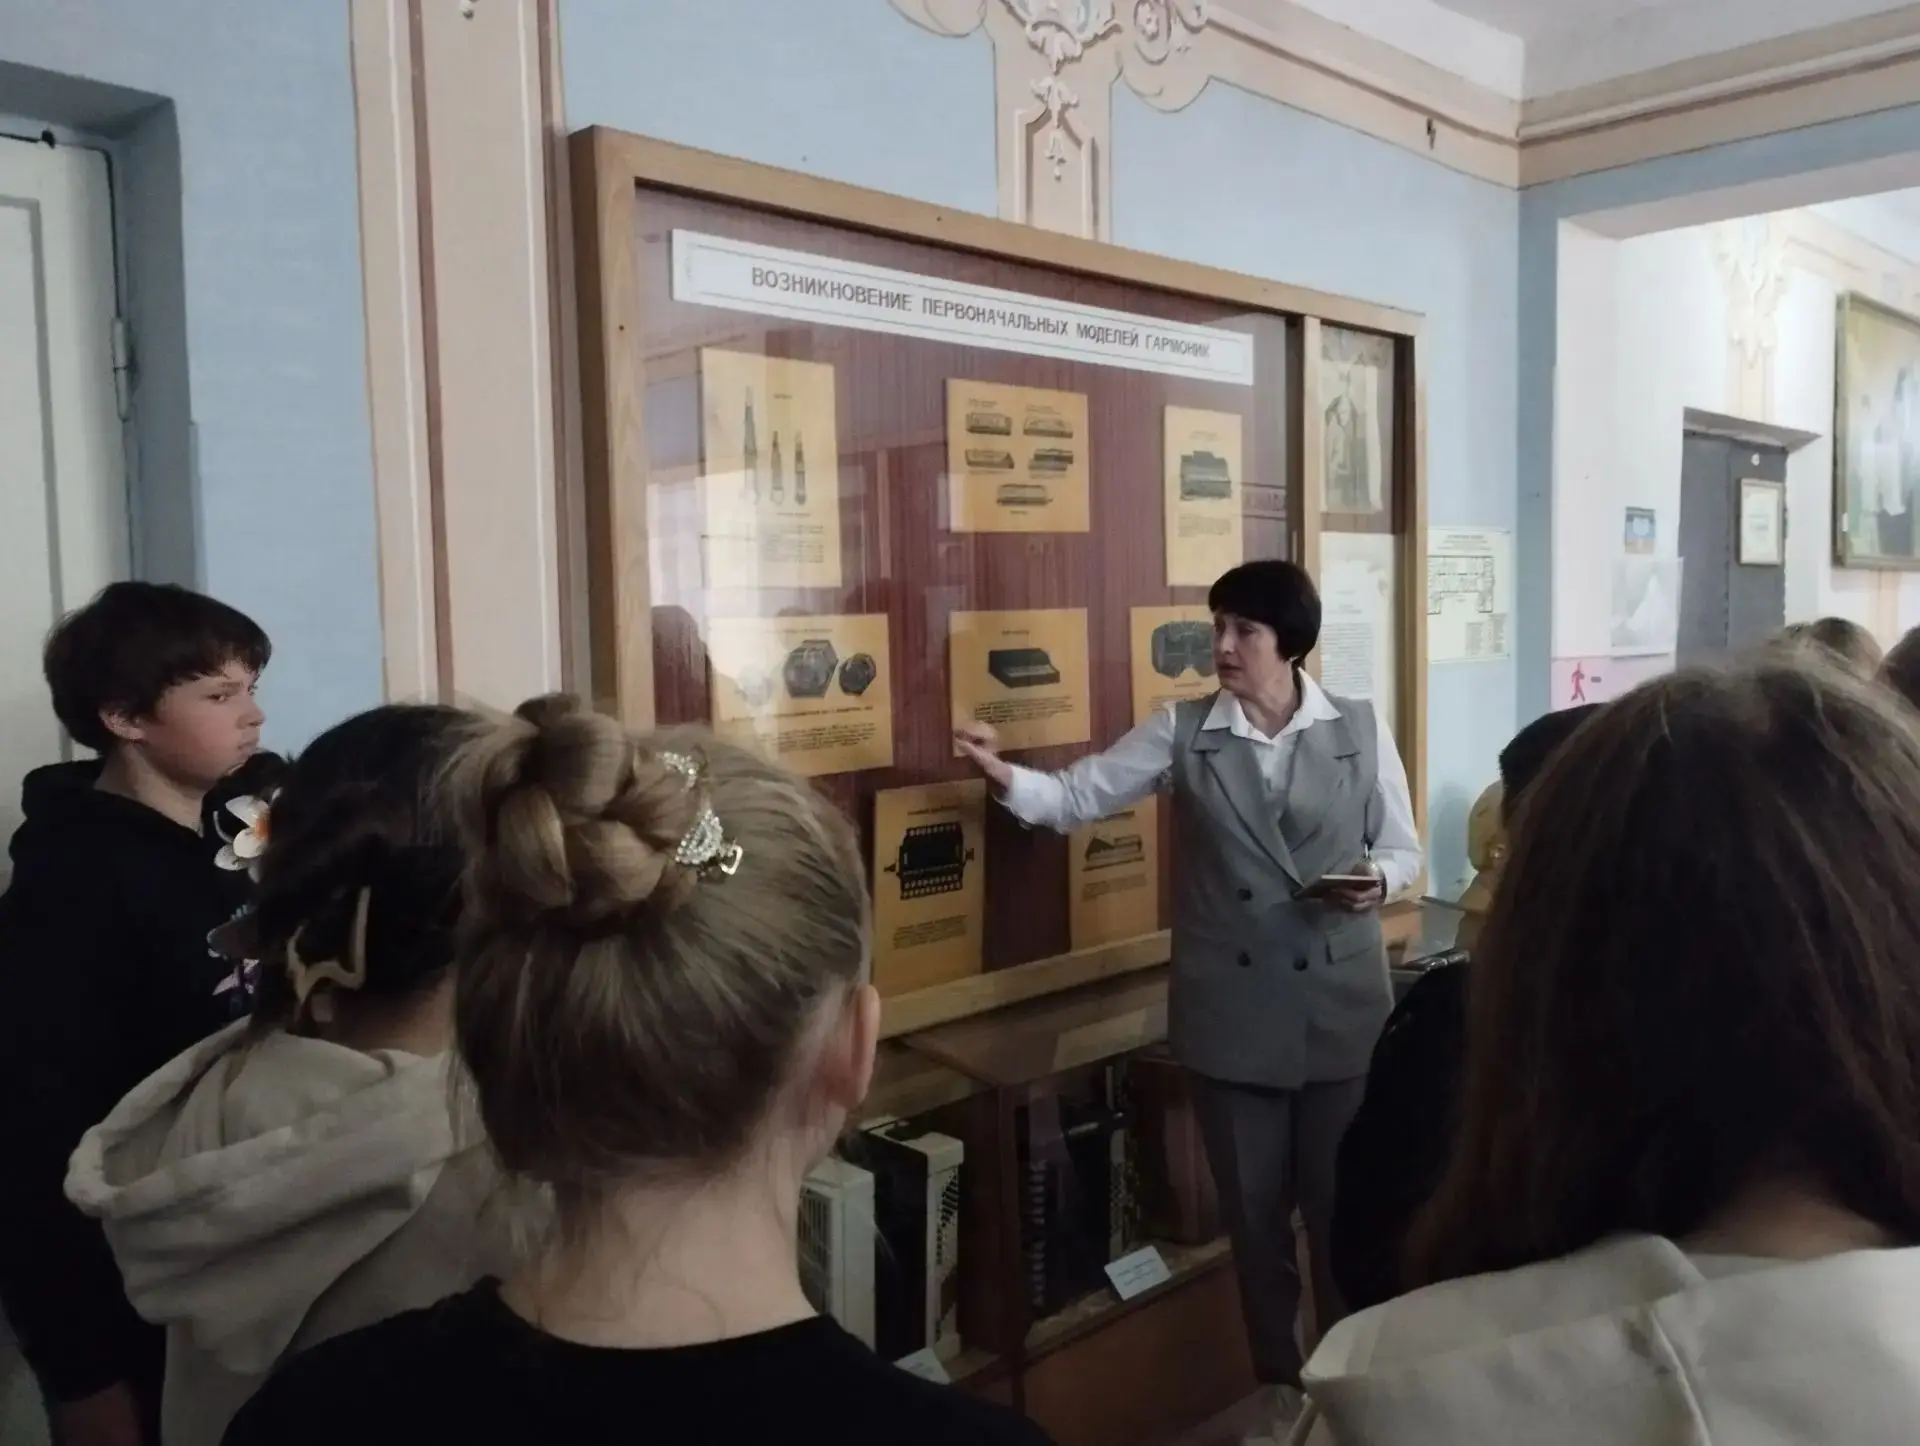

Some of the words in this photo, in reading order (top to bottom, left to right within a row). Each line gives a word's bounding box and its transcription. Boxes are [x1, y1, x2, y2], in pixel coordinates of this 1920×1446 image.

[752, 266, 912, 312] ВОЗНИКНОВЕНИЕ
[922, 297, 1068, 336] ПЕРВОНАЧАЛЬНЫХ
[1076, 322, 1139, 348] МОДЕЛЕЙ
[1145, 334, 1210, 358] ГАРМОНИК
